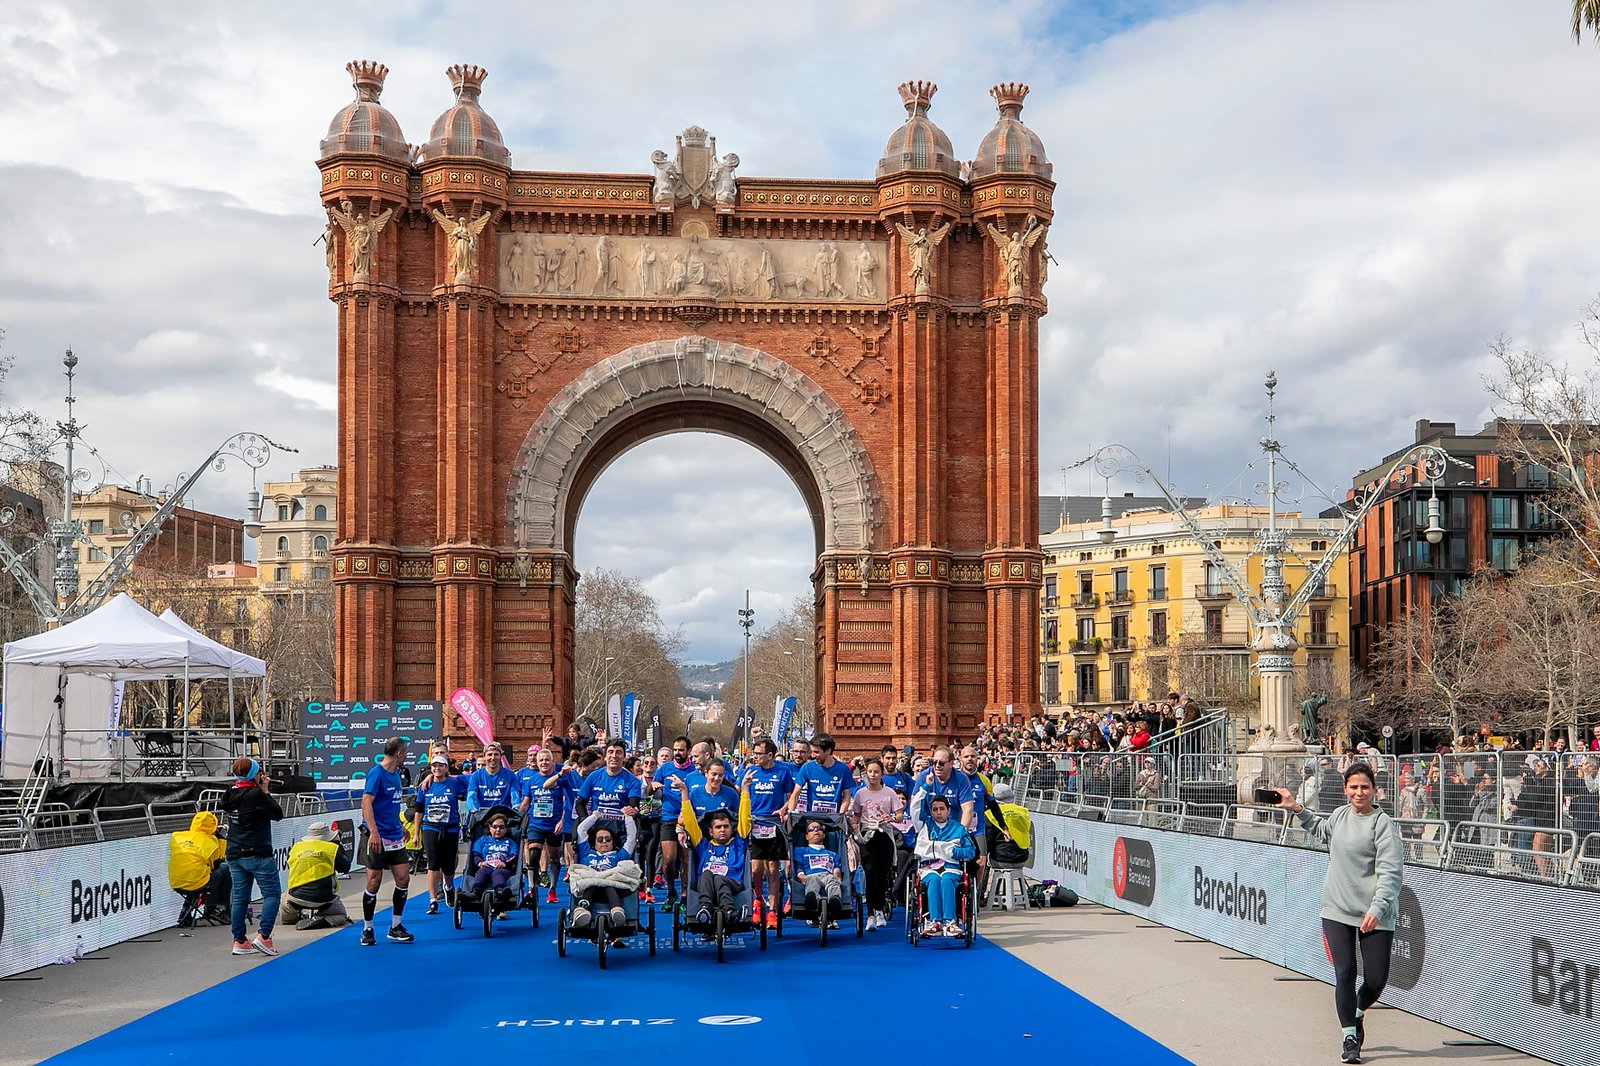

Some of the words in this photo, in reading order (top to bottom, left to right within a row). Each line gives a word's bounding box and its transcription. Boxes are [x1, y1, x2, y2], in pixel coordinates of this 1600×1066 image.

[1053, 836, 1088, 876] Barcelona
[1129, 867, 1151, 887] Barcelona
[71, 868, 151, 923] Barcelona
[1194, 865, 1267, 925] Barcelona
[1531, 935, 1600, 1019] Bar
[496, 1017, 676, 1027] ZURICH
